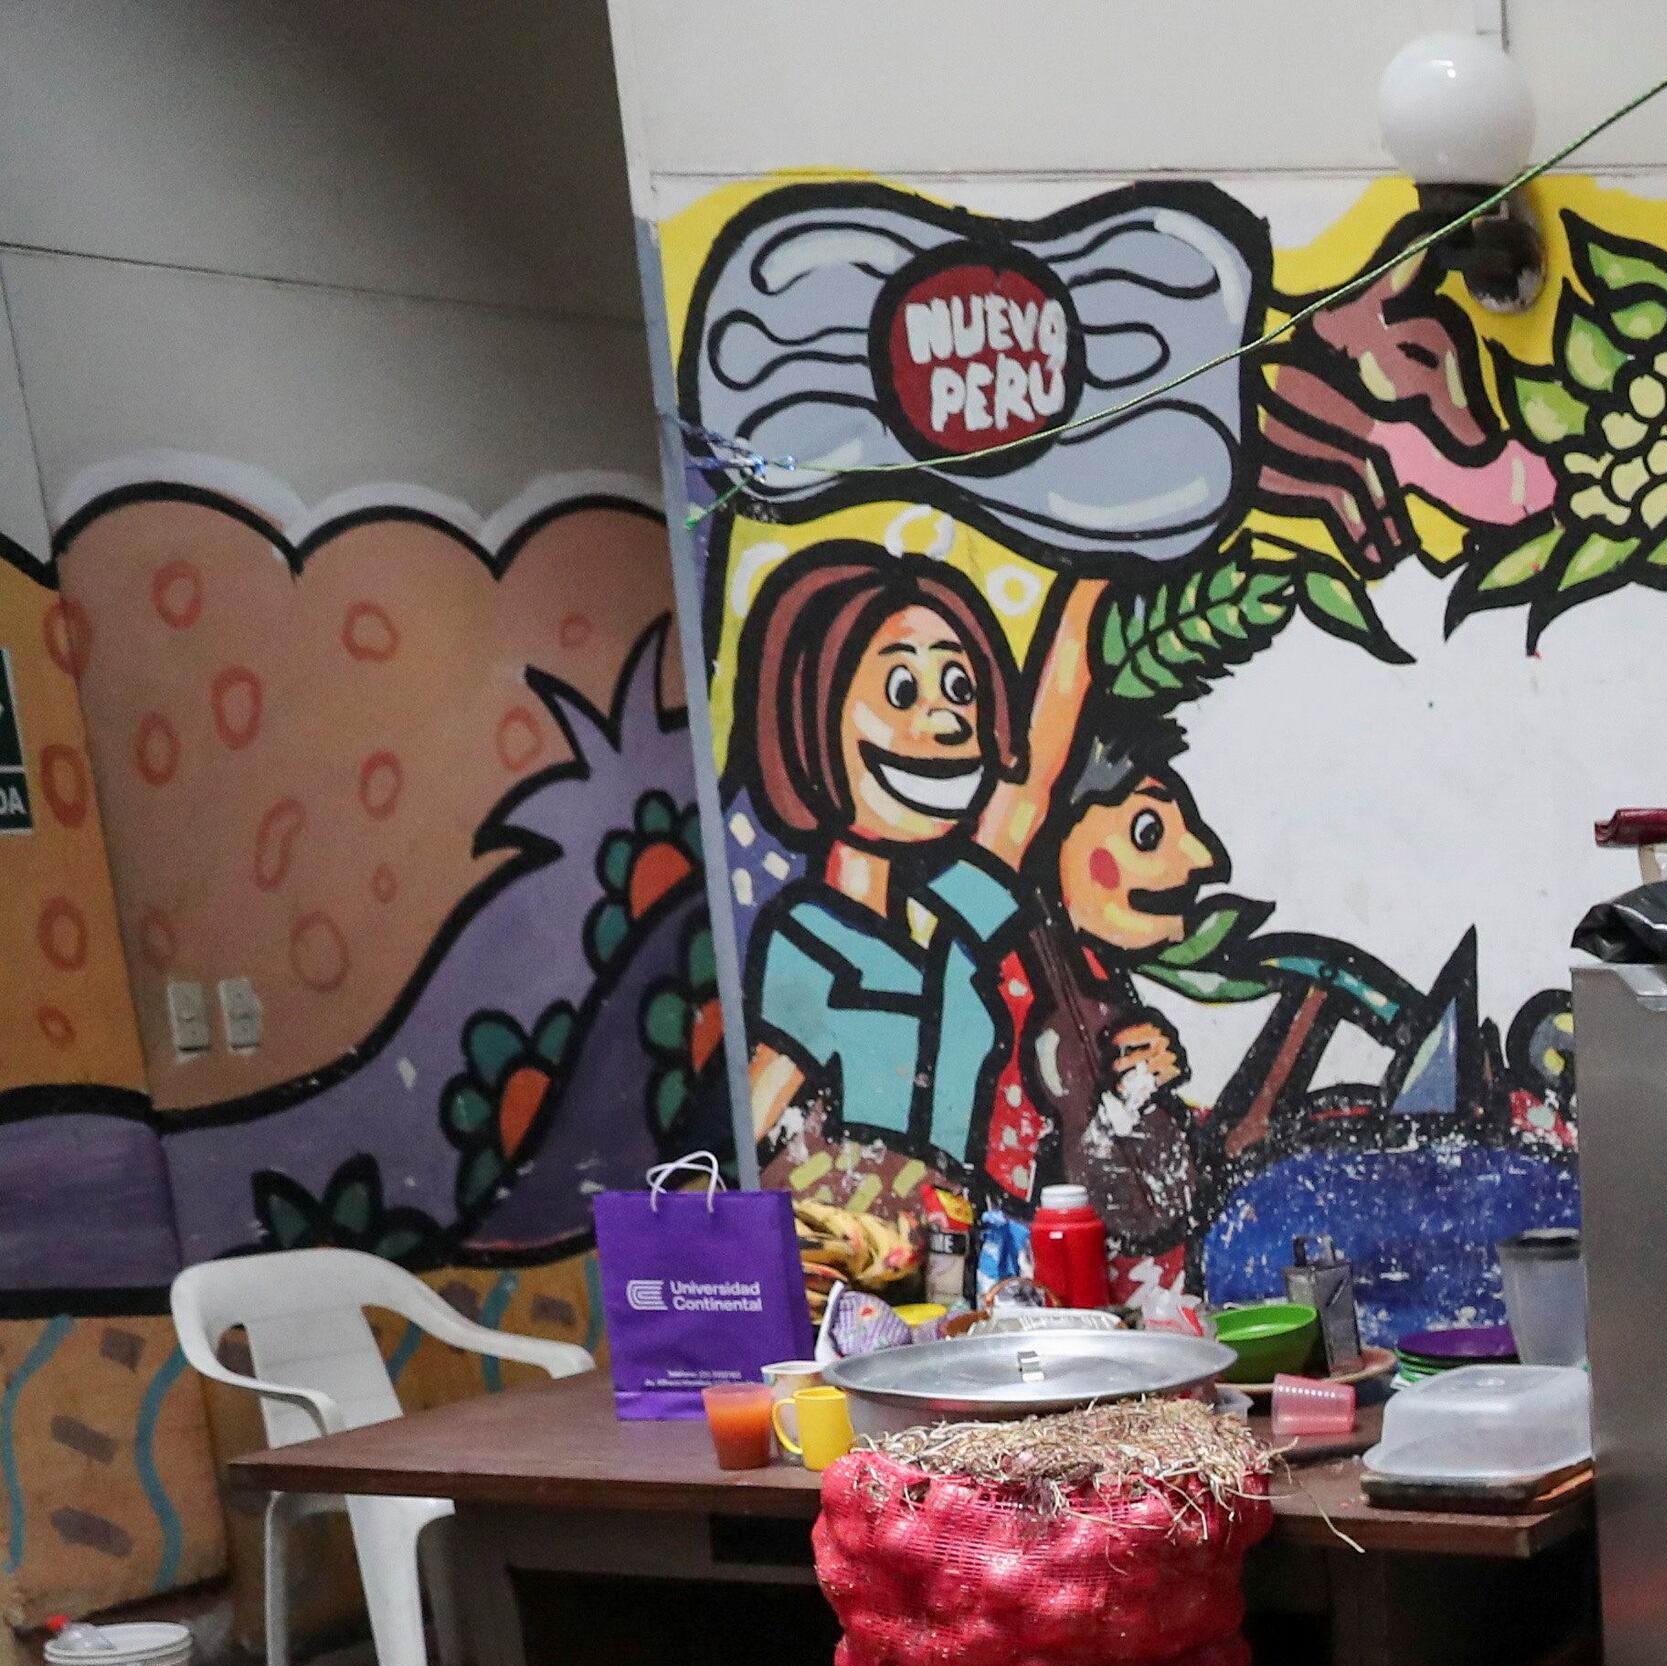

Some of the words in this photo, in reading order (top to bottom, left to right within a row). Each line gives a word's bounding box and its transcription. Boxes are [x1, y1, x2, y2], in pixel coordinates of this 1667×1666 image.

[904, 292, 1068, 366] NUEVO
[669, 1280, 761, 1297] Universidad
[672, 1296, 763, 1313] Continental
